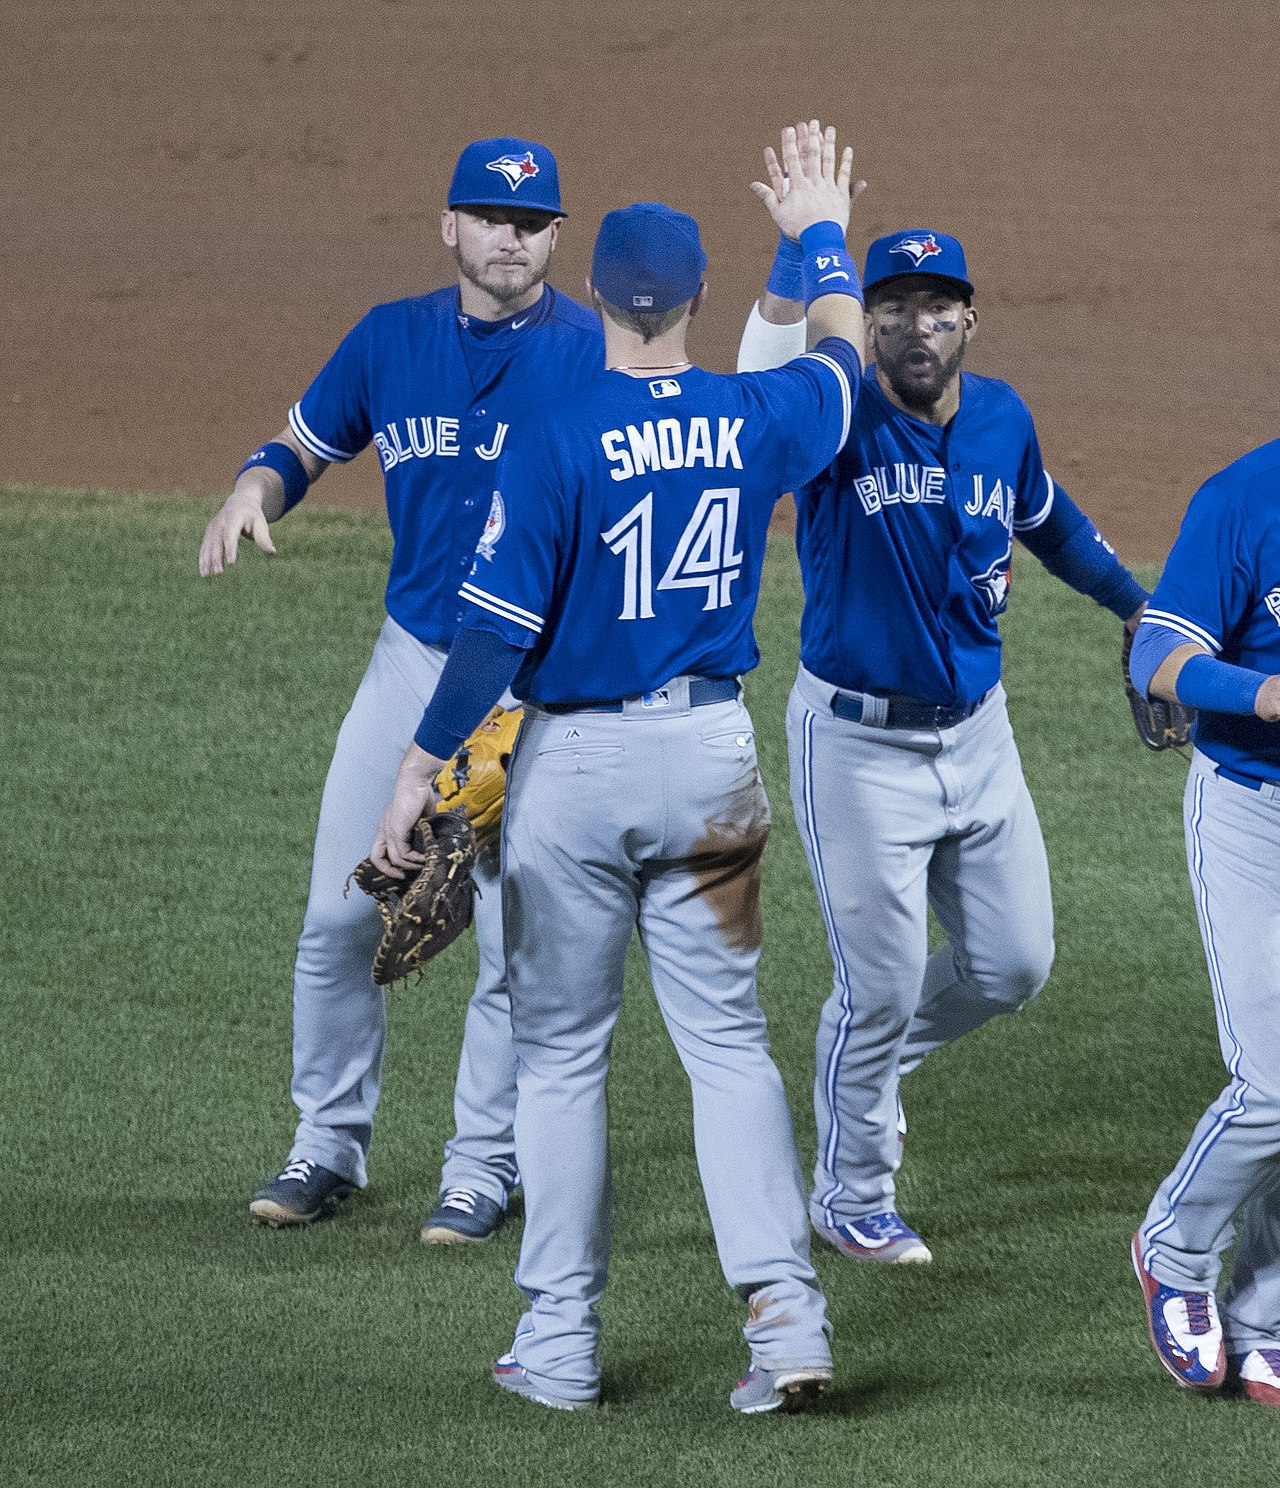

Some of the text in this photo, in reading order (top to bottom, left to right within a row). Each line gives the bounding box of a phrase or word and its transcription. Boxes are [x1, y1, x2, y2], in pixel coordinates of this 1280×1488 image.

[815, 255, 842, 270] 14
[373, 416, 460, 472] BLUE
[601, 417, 744, 482] SMOAK
[853, 463, 946, 516] BLUE
[600, 487, 744, 620] 14
